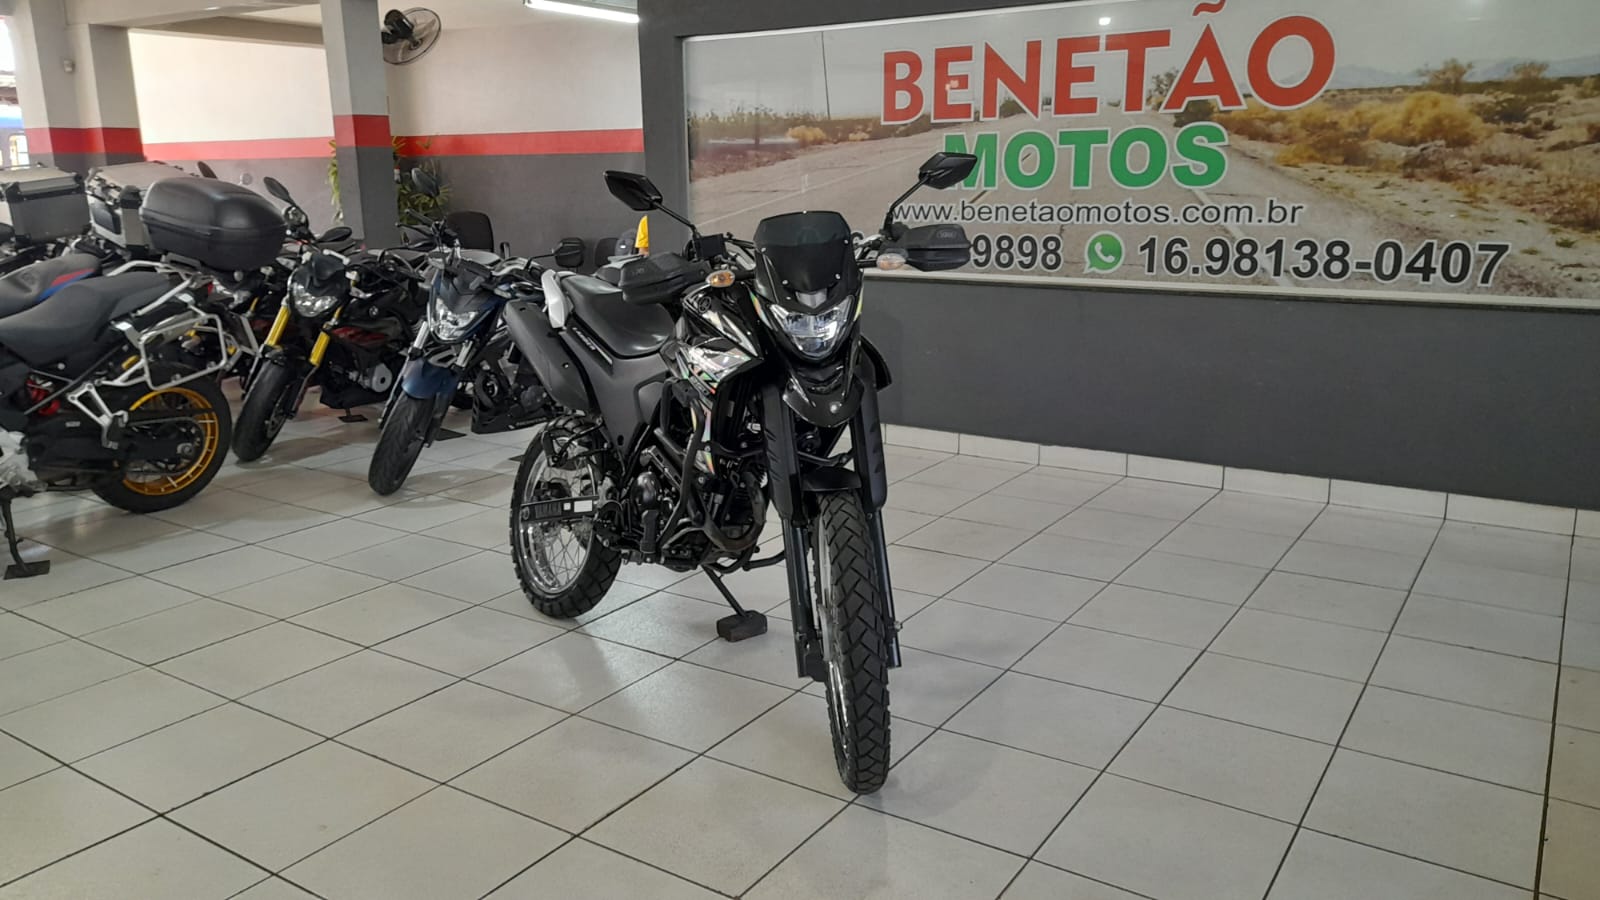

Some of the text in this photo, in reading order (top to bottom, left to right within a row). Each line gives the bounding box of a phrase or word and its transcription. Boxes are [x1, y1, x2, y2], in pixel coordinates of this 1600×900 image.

[881, 0, 1336, 124] BENETÃO
[943, 124, 1229, 191] MOTOS
[892, 200, 1304, 226] www.benetaomotos.com.br
[1138, 236, 1510, 285] 16.98138-0407
